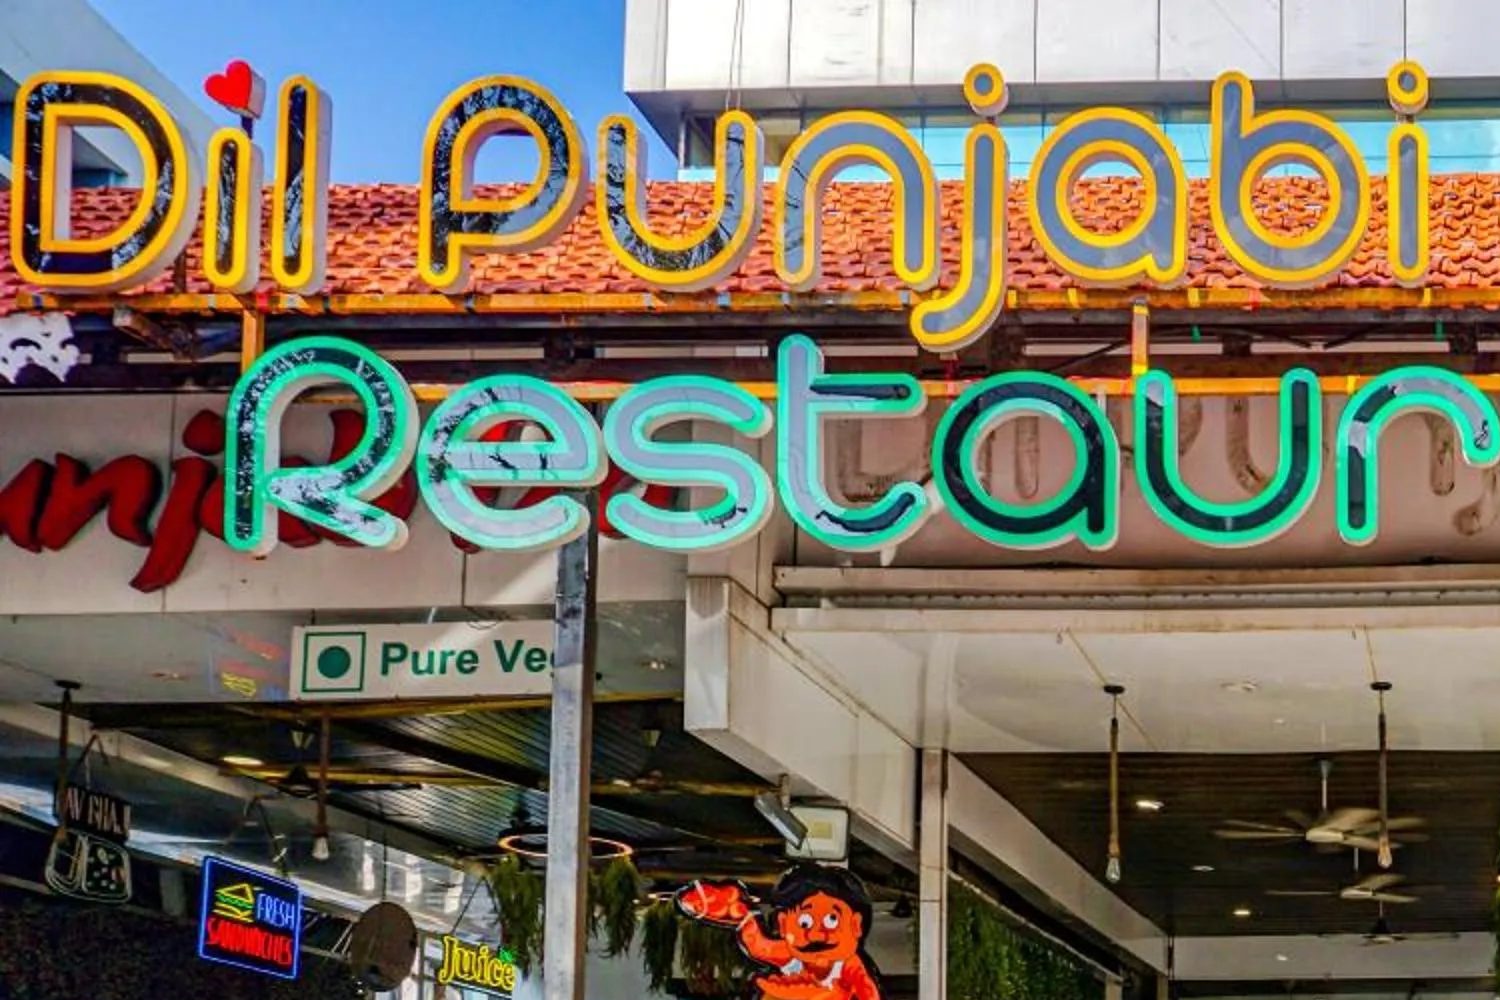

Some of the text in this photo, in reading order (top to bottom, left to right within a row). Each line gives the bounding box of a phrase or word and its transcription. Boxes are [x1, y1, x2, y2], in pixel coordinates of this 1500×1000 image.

[12, 62, 322, 291] Dil
[418, 61, 1430, 348] Punjabi
[380, 639, 556, 678] Pure Ve
[257, 893, 296, 930] FRESH
[438, 935, 515, 991] Juice
